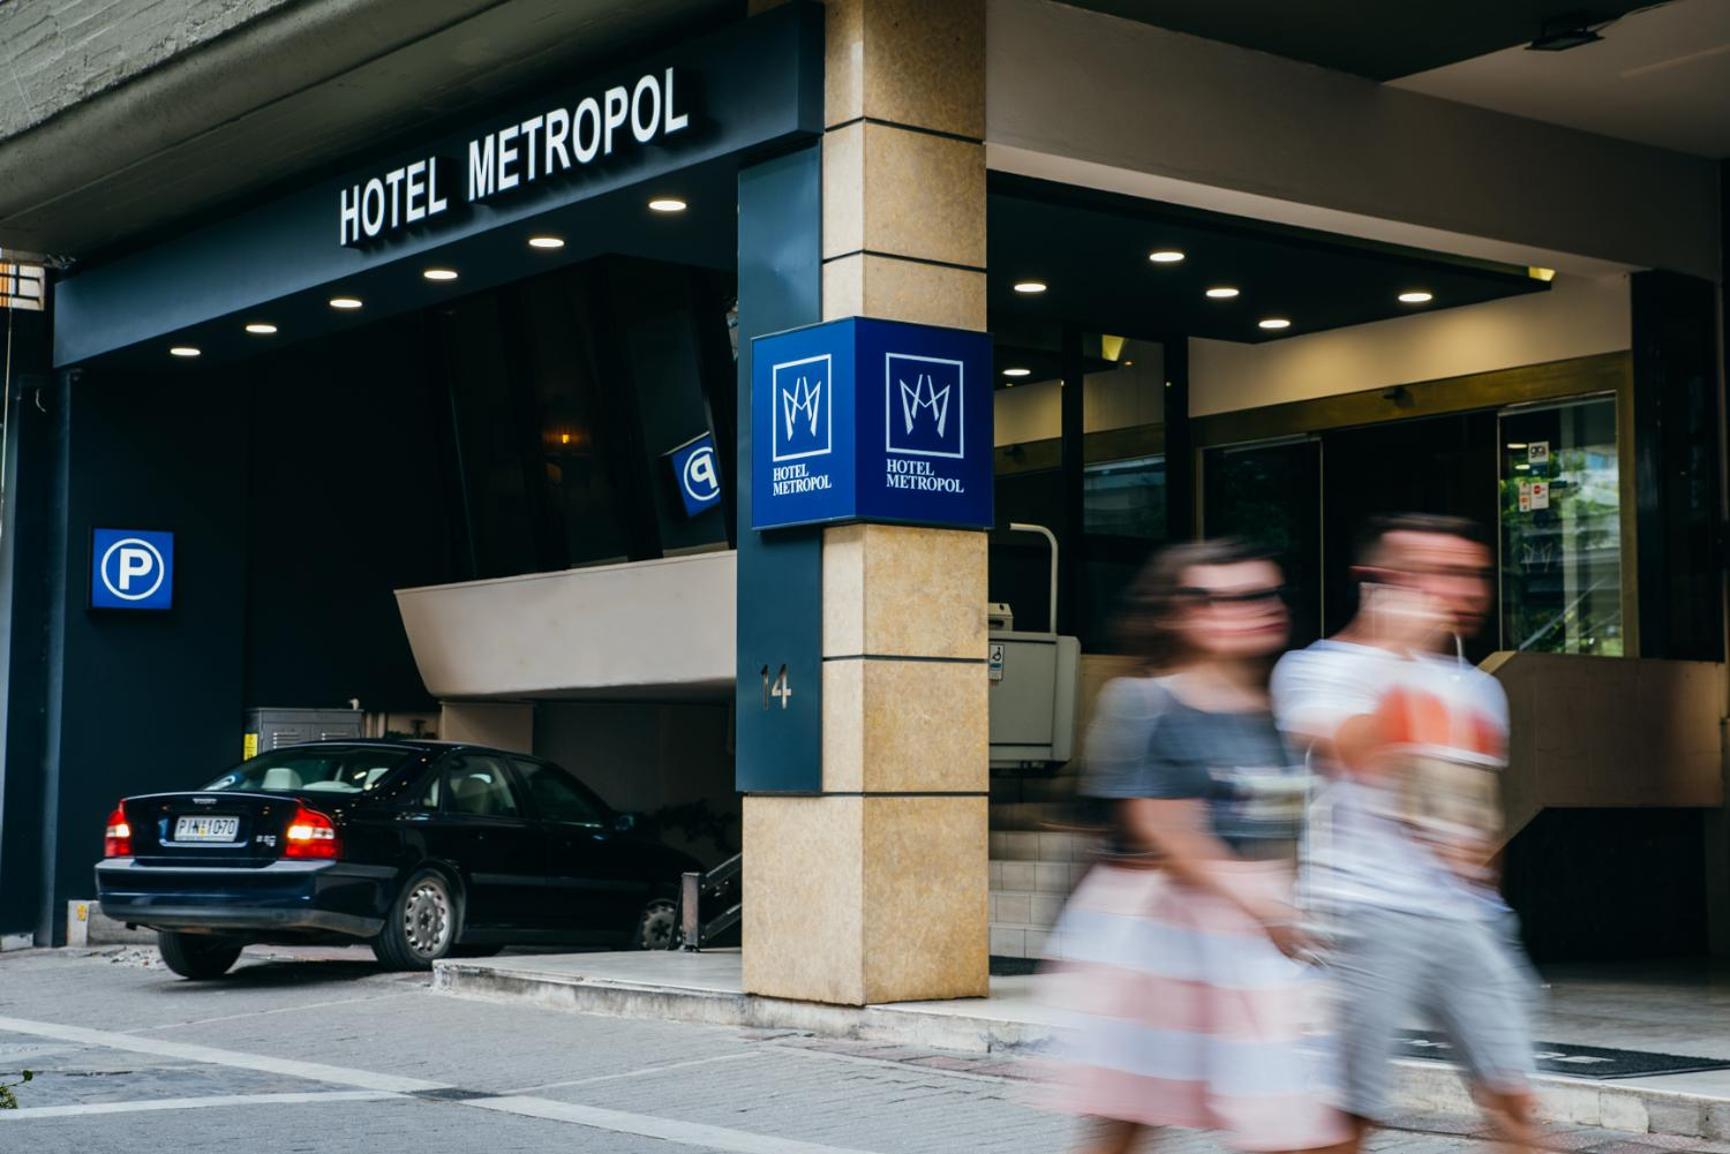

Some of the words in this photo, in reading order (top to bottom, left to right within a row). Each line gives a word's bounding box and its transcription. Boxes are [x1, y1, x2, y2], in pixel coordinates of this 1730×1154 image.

[340, 157, 447, 246] HOTEL
[468, 67, 688, 202] METROPOL
[773, 463, 809, 482] HOTEL
[886, 458, 935, 476] HOTEL
[773, 475, 832, 496] METROPOL
[886, 473, 964, 494] METROPOL
[119, 547, 153, 590] P
[760, 663, 792, 710] 14
